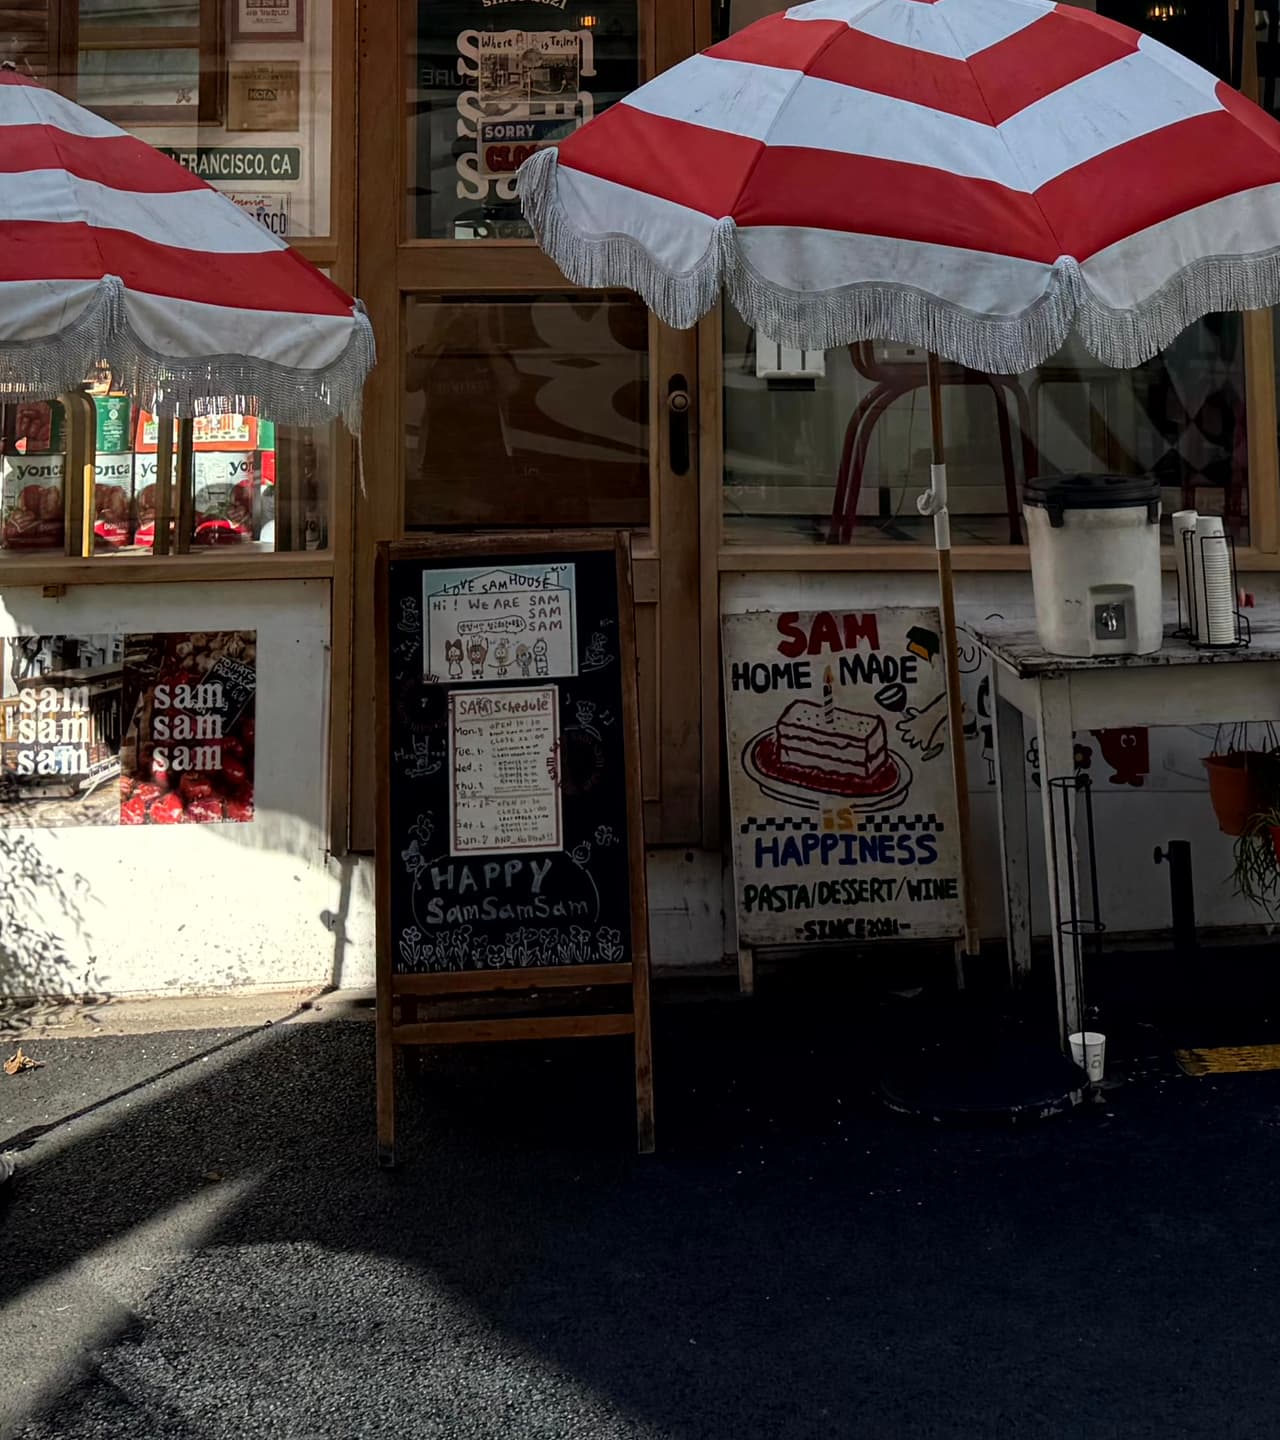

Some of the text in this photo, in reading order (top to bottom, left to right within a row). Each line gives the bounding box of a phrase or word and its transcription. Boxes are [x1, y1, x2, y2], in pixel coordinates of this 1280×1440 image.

[485, 124, 535, 139] SORRY
[271, 153, 292, 175] CA
[483, 580, 508, 594] SAM
[509, 574, 551, 589] HOUSE
[494, 596, 521, 609] ARE
[529, 594, 560, 607] SAM
[528, 606, 562, 620] SAM
[528, 620, 563, 633] SAM
[777, 611, 880, 657] SAM
[732, 661, 812, 693] HOME
[839, 653, 918, 686] MADE
[18, 683, 90, 713] sam
[153, 682, 224, 711] sam
[493, 696, 550, 713] Schedule
[18, 715, 90, 744] sam
[153, 713, 224, 741] sam
[16, 747, 89, 775] sam
[152, 744, 223, 772] sam
[823, 808, 854, 831] is
[755, 833, 938, 868] HAPPINESS
[429, 858, 553, 894] HAPPY
